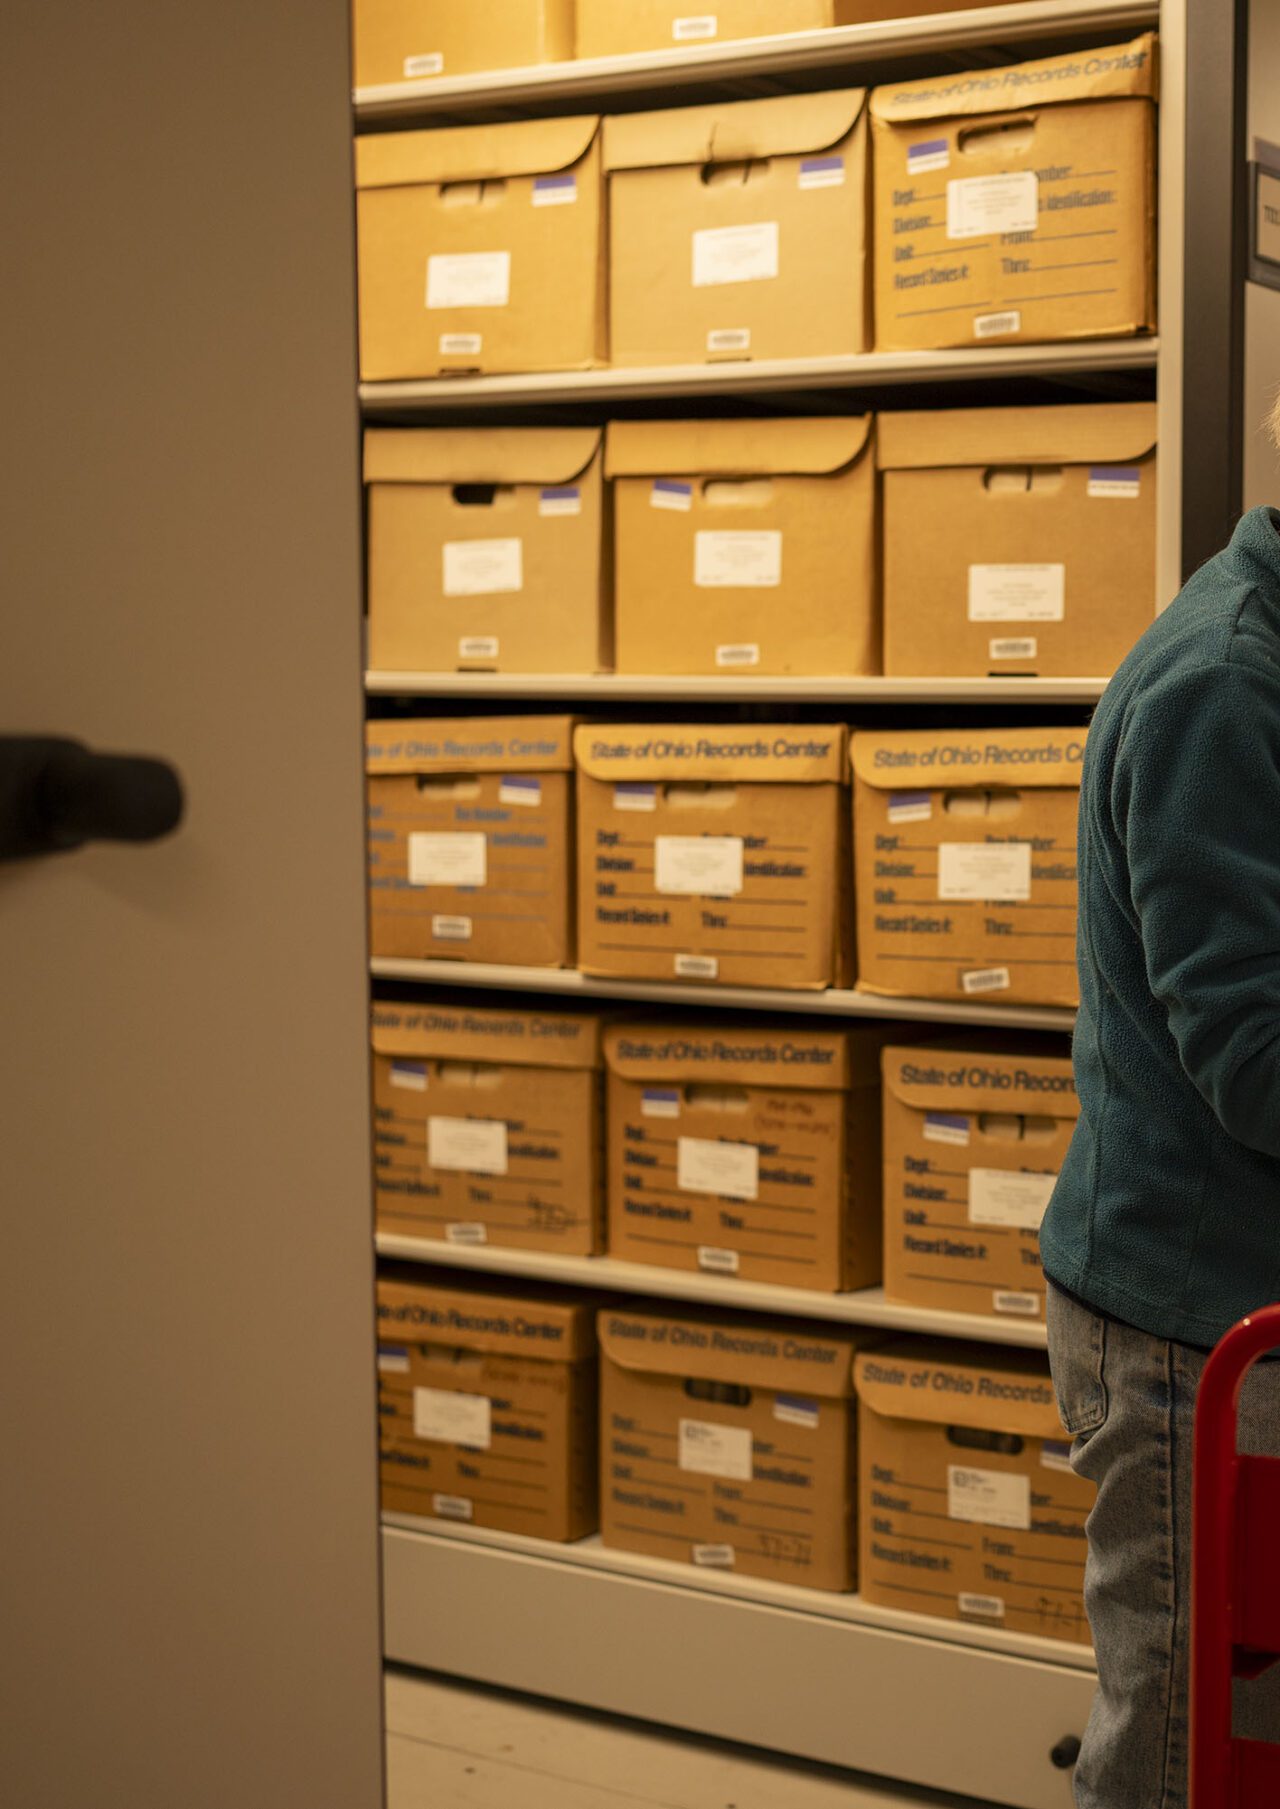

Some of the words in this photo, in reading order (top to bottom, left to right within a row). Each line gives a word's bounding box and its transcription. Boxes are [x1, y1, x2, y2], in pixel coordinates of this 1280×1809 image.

[1001, 65, 1082, 88] Records
[1084, 53, 1147, 76] Center
[509, 739, 559, 755] Center
[592, 742, 632, 759] State
[634, 742, 651, 757] of
[652, 741, 694, 758] Ohio
[697, 741, 769, 758] Records
[773, 739, 832, 757] Center
[875, 749, 917, 768] State
[919, 749, 938, 766] of
[939, 747, 982, 766] Ohio
[985, 745, 1063, 766] Records
[531, 1018, 581, 1037] Center
[618, 1039, 655, 1059] State
[657, 1042, 673, 1059] of
[673, 1041, 709, 1060] Ohio
[712, 1042, 778, 1062] Records
[781, 1045, 836, 1064] Center
[902, 1065, 945, 1085] State
[947, 1067, 967, 1087] of
[968, 1068, 1012, 1089] Ohio
[514, 1317, 564, 1339] Center
[611, 1320, 646, 1339] State
[652, 1323, 667, 1340] of
[671, 1326, 708, 1347] Ohio
[713, 1333, 778, 1356] Records
[784, 1340, 837, 1363] Center
[865, 1364, 905, 1385] State
[912, 1372, 930, 1388] of
[934, 1373, 975, 1394] Ohio
